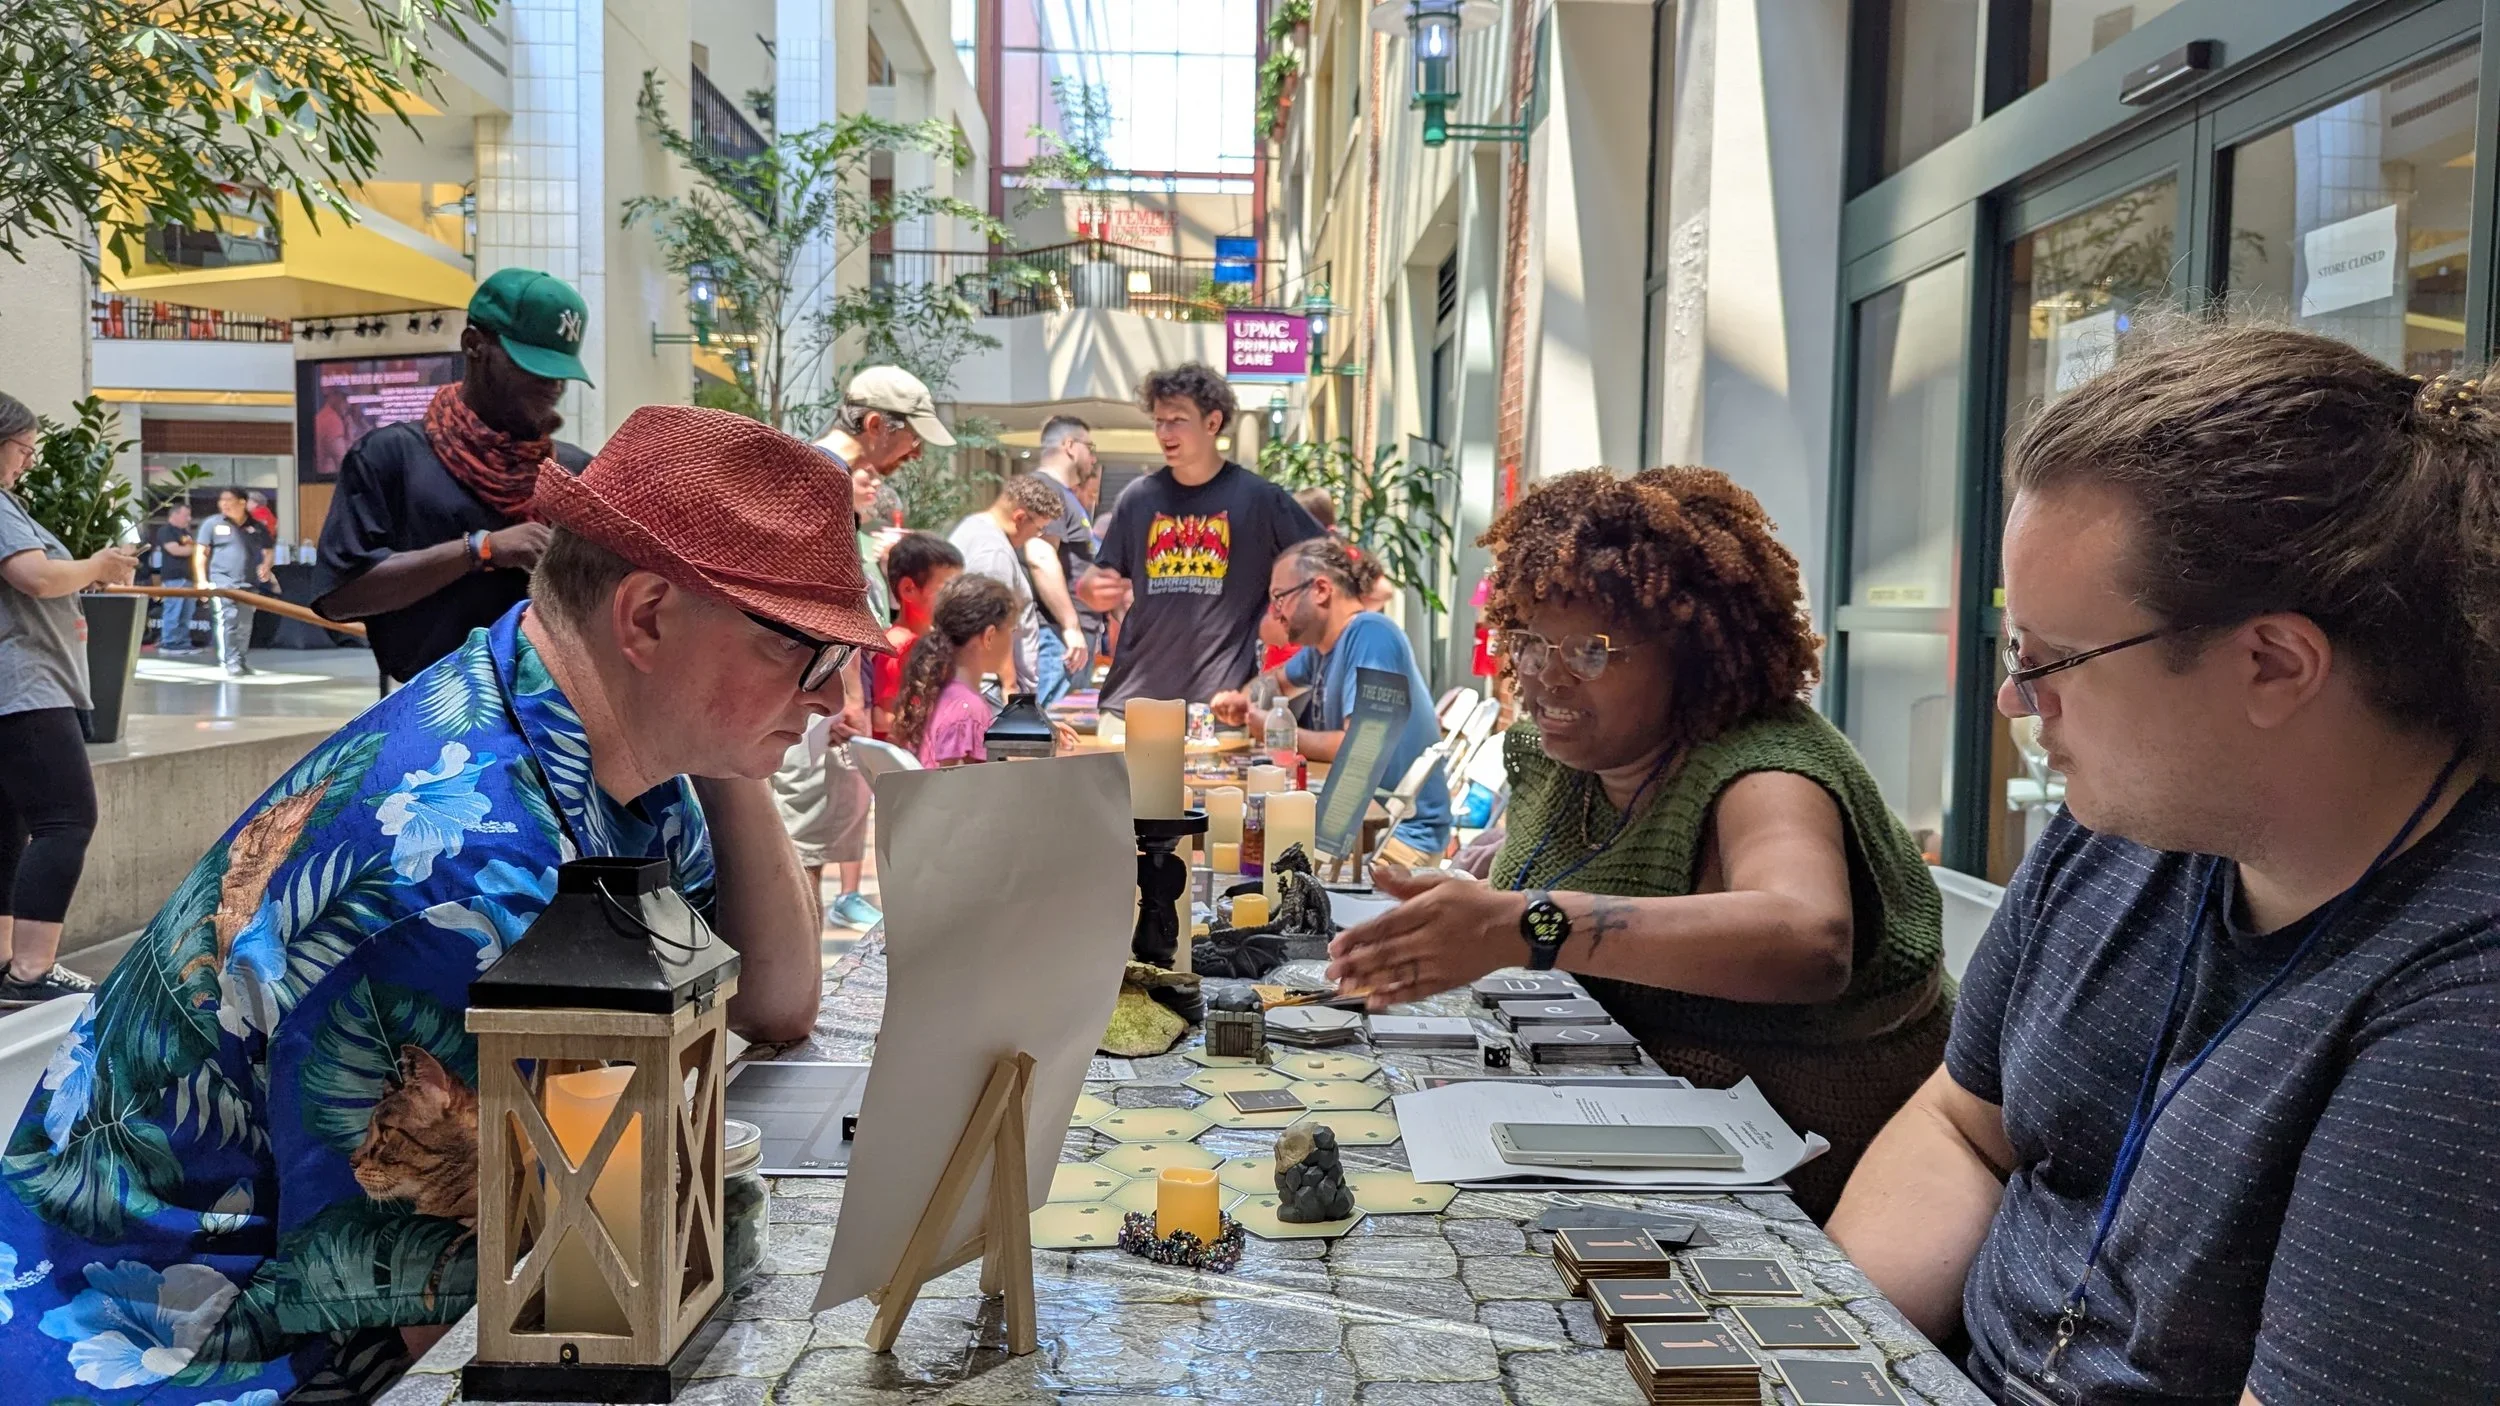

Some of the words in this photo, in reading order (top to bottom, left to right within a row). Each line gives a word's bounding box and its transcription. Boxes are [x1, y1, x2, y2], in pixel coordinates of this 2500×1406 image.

[1115, 209, 1178, 226] TEMPLE
[2317, 260, 2347, 278] STORE
[2348, 250, 2386, 271] CLOSED
[556, 309, 582, 342] NY
[1233, 320, 1289, 339] UPMC
[1233, 339, 1299, 354] PRIMARY
[1233, 352, 1274, 366] CARE
[1148, 576, 1223, 589] HARRISBURG
[1189, 585, 1203, 595] Day
[1362, 684, 1378, 700] THE
